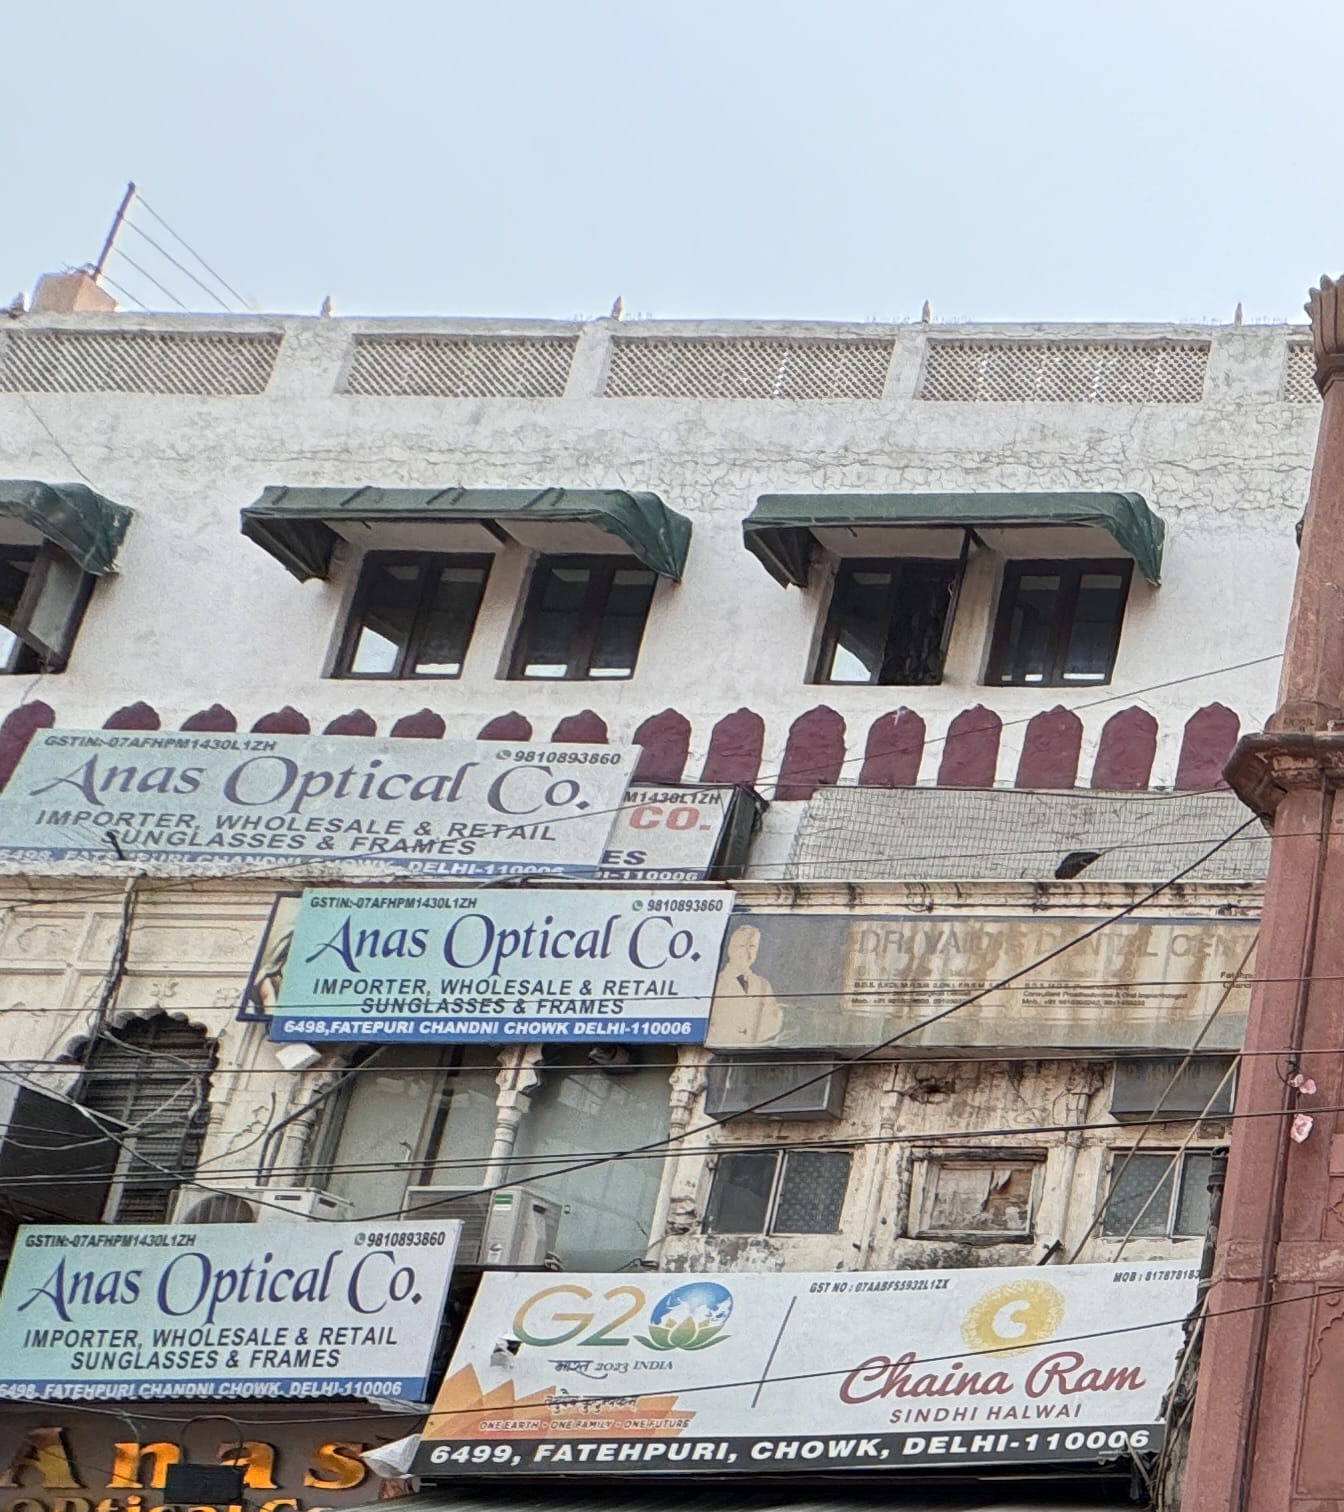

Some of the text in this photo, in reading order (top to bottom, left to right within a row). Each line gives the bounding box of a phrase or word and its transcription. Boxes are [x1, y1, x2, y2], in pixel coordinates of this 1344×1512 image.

[513, 750, 622, 766] 9810893860
[29, 753, 591, 815] Anas Optical Co.
[35, 810, 558, 842] IMPORTER, WHOLESALE & RETAIL
[628, 806, 711, 831] CO.
[101, 830, 477, 855] SUNGLASSES & FRAMES
[602, 850, 648, 865] ES
[647, 899, 724, 912] 9810893860
[305, 914, 702, 979] Anas Optical Co.
[313, 979, 679, 997] IMPORTER, WHOLESALE & RETAIL
[361, 998, 625, 1014] SUNGLASSES & FRAMES
[419, 1021, 499, 1034] CHANDNI
[504, 1021, 570, 1034] CHOWK
[573, 1021, 692, 1035] DELHI-110006
[366, 1231, 446, 1247] 9810893860
[1113, 1269, 1200, 1283] MOB 817878183
[17, 1250, 423, 1326] Anas Optical Co.
[809, 1280, 832, 1293] GST
[833, 1280, 847, 1292] NO
[23, 1327, 398, 1349] IMPORTER, WHOLESALE & RETAIL
[70, 1349, 341, 1370] SUNGLASSES & FRAMES
[595, 1361, 630, 1374] 2023
[633, 1360, 673, 1371] INDIA
[839, 1351, 1147, 1405] Chaina Ram
[138, 1383, 215, 1398] CHANDNI
[290, 1381, 402, 1396] DELHI-110006
[889, 1404, 1083, 1424] SINDHI HALWAI
[480, 1420, 499, 1431] ONE
[551, 1420, 572, 1430] ONE
[624, 1419, 646, 1430] ONE
[429, 1429, 1151, 1467] 6499, FATEHPURI, CHOWK, DELHI-110006
[0, 1426, 370, 1491] Anas
